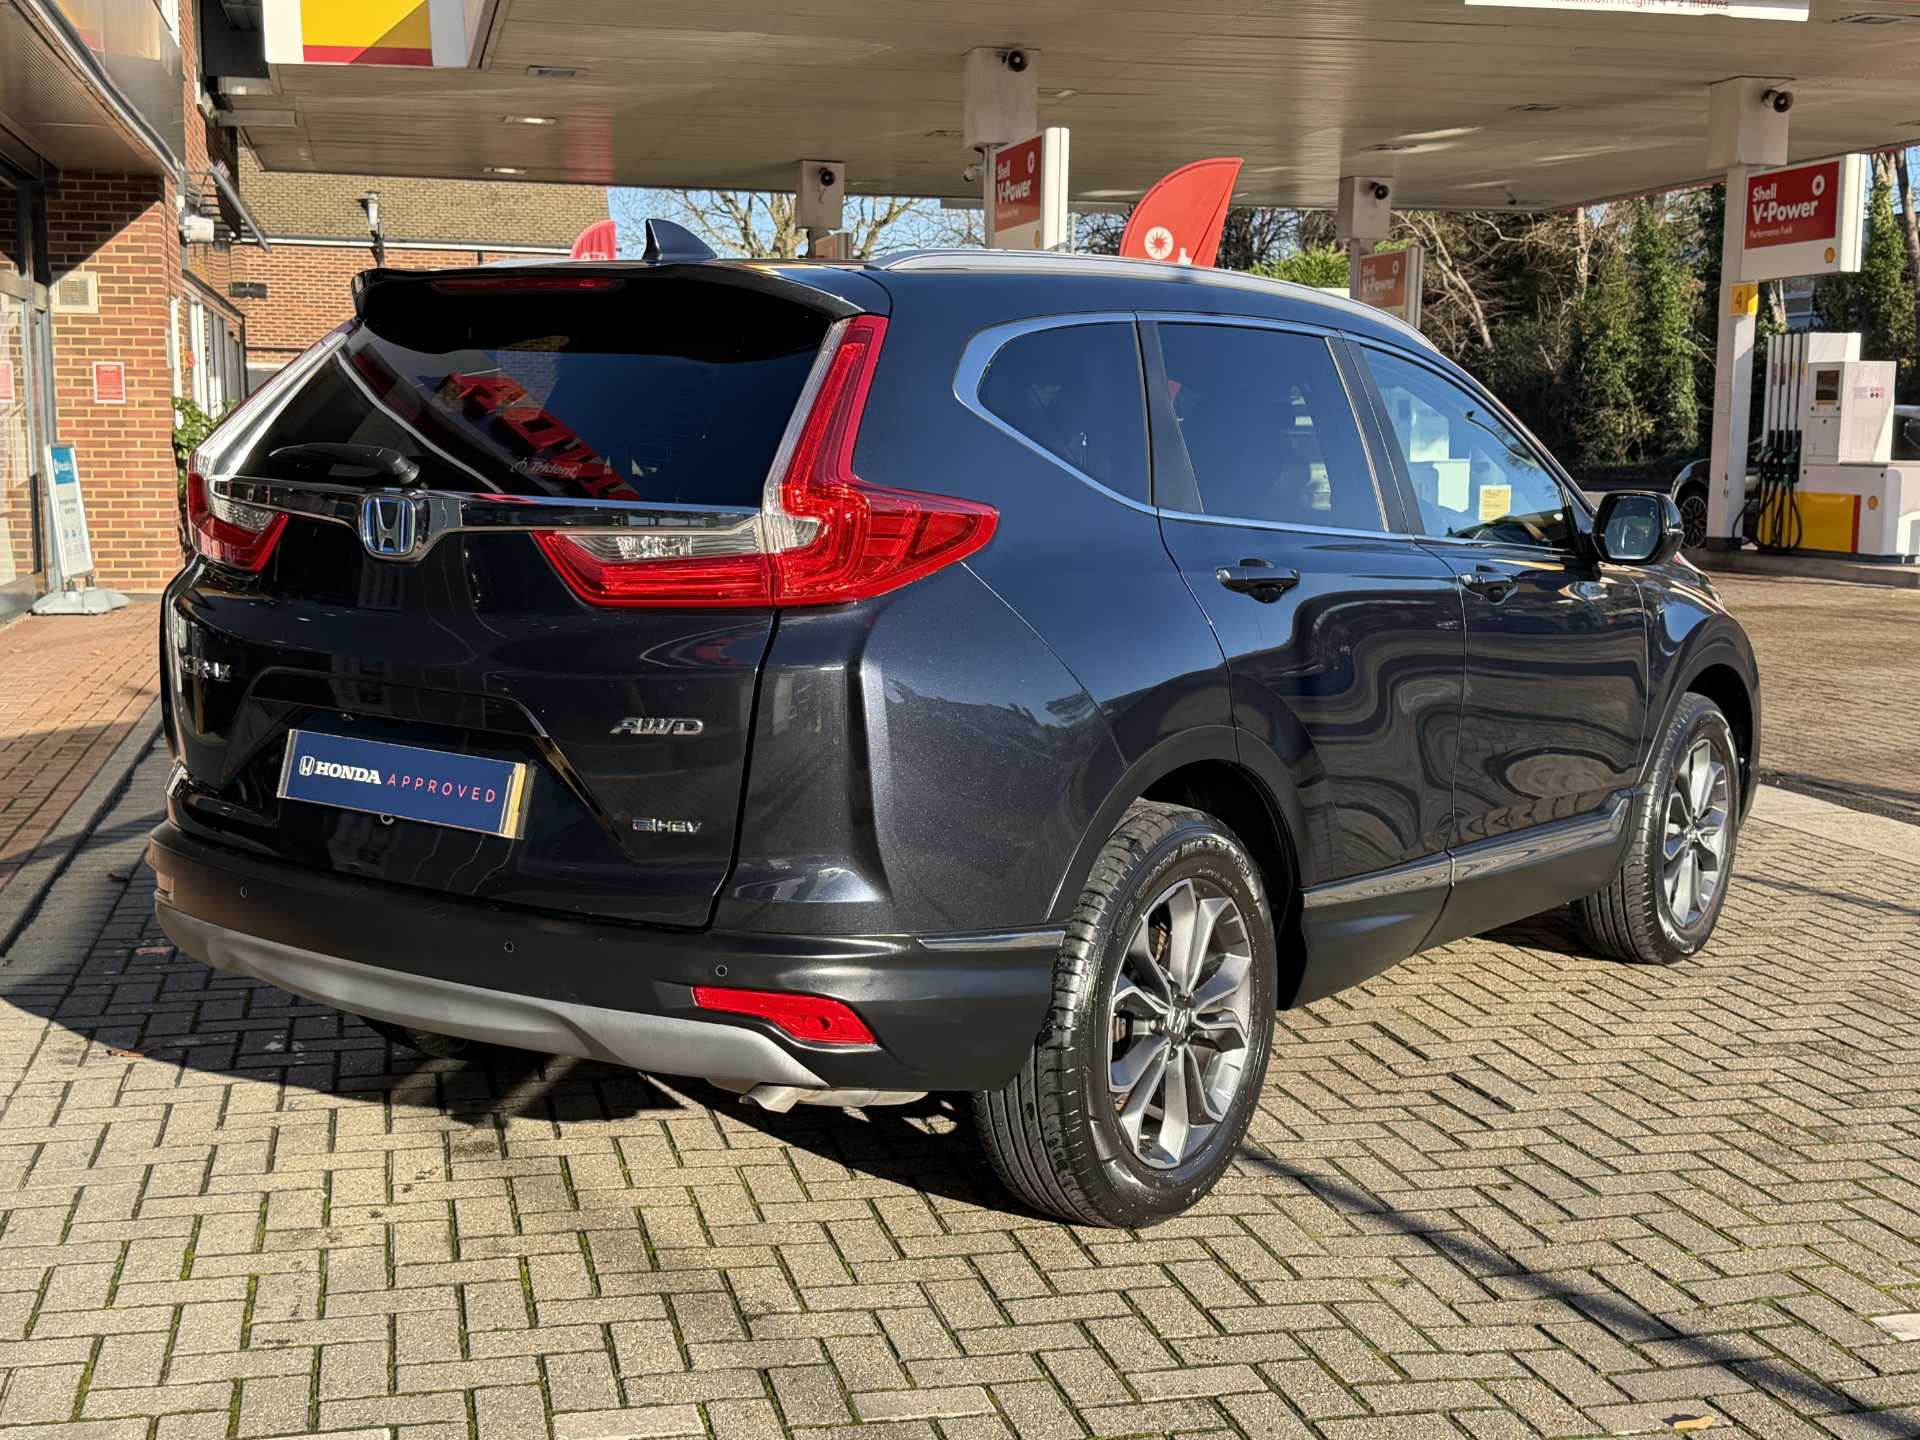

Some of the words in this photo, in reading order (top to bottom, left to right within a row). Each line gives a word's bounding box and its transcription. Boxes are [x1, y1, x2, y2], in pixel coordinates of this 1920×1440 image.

[1752, 183, 1777, 202] Shell
[1752, 200, 1818, 224] V-Power
[1735, 290, 1743, 308] 4
[609, 717, 704, 736] AWD
[315, 760, 382, 785] HONDA
[386, 773, 496, 803] APPROVED
